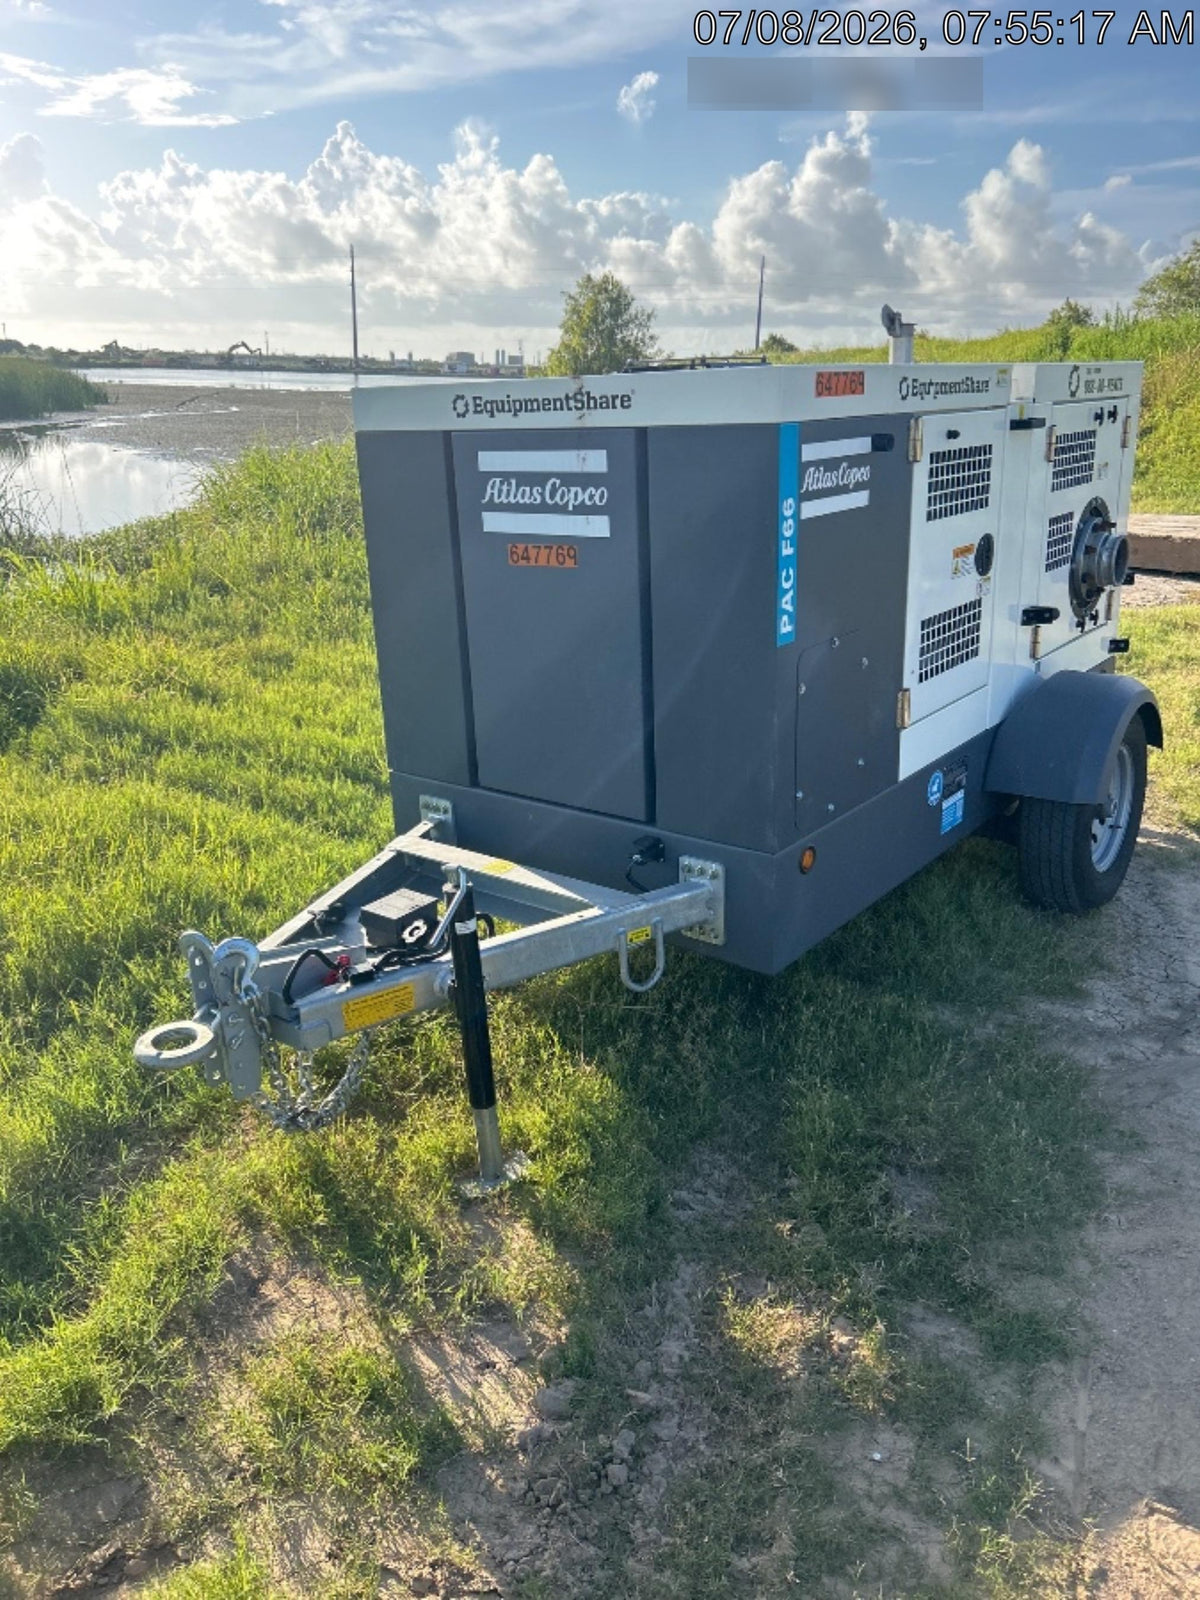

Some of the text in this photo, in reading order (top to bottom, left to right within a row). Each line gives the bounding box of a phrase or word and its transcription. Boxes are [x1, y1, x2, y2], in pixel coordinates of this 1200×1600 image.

[815, 371, 864, 397] 647769
[472, 390, 632, 418] EquipmentShare
[800, 461, 870, 493] Atlas Copco
[481, 477, 608, 511] Atlas Copco
[509, 545, 577, 566] 647769
[780, 497, 795, 635] PAC F66
